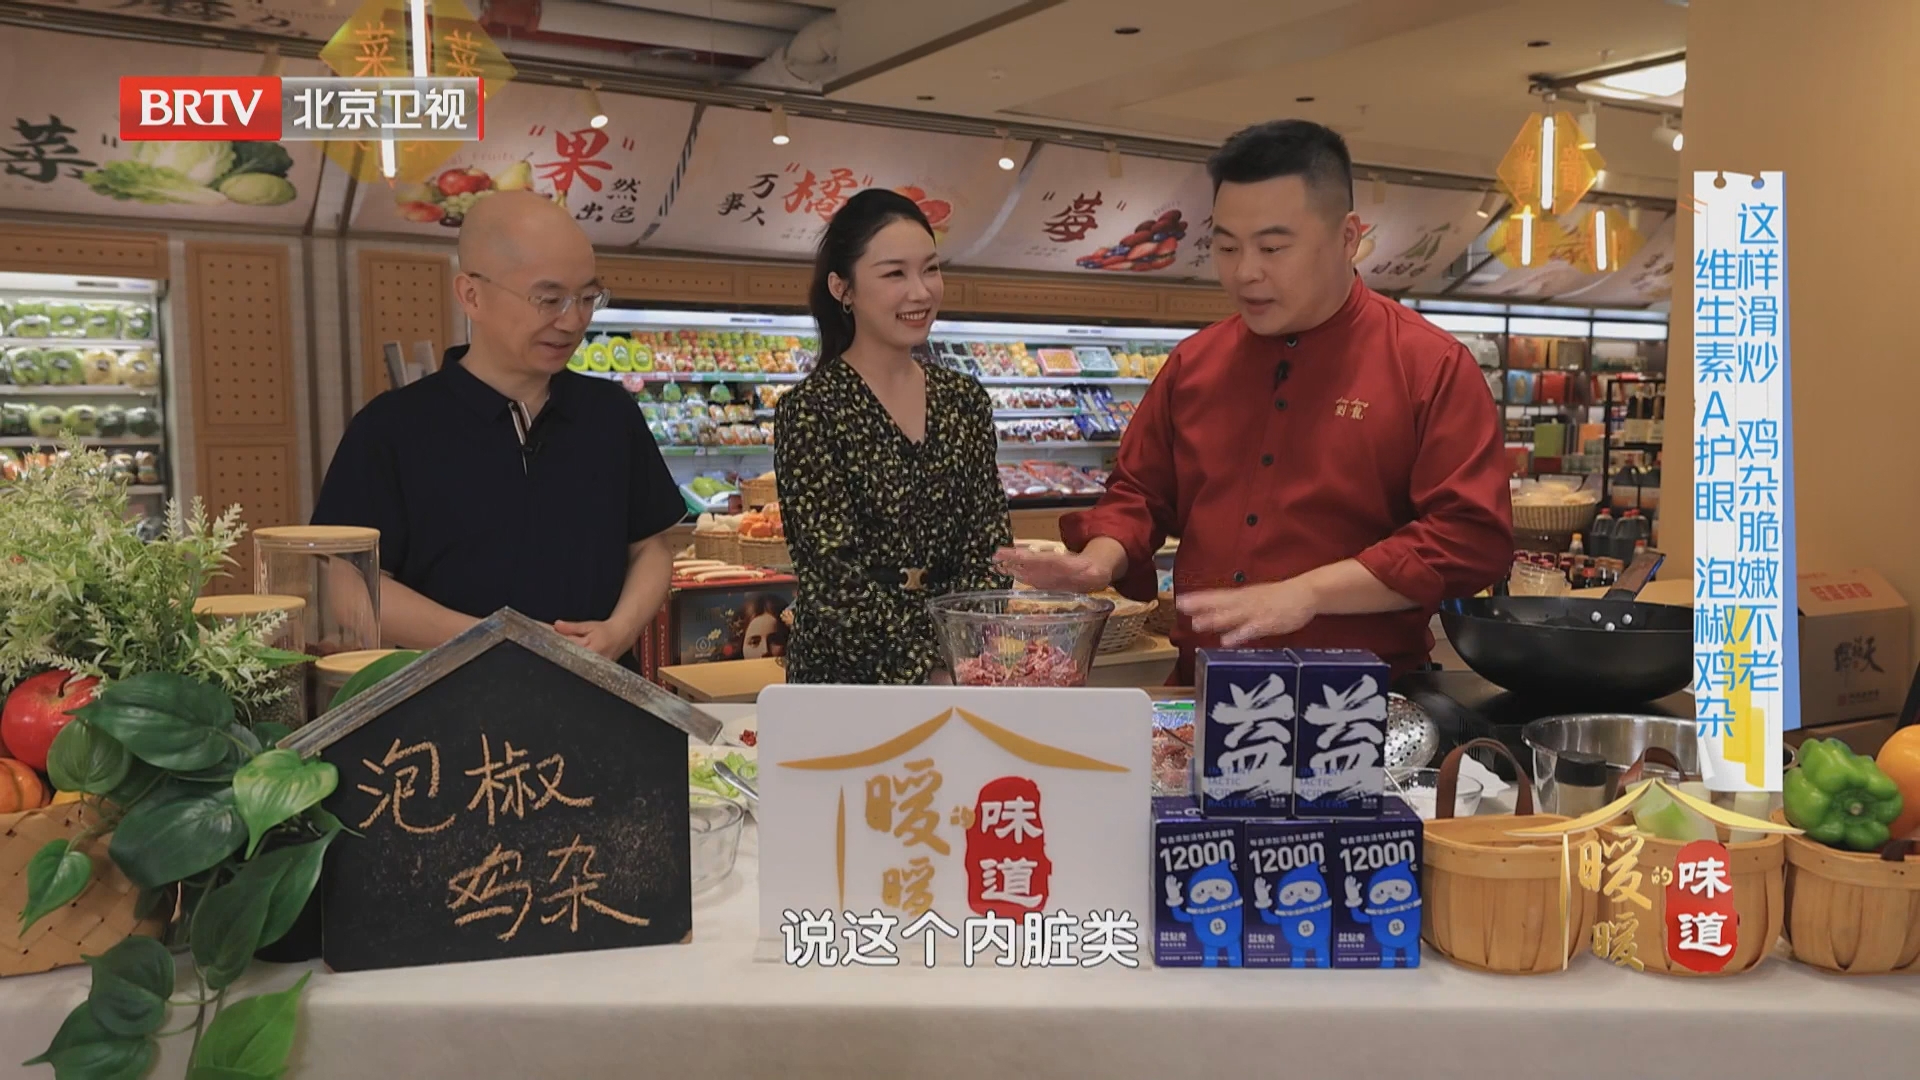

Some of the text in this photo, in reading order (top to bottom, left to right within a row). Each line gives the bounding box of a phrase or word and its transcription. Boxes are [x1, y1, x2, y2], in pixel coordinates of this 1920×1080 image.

[358, 734, 594, 834] 泡椒
[447, 834, 650, 941] 鸡杂
[865, 758, 950, 917] 暖暖
[980, 796, 1044, 906] 味道
[1160, 840, 1235, 872] 12000
[1249, 842, 1325, 874] 12000
[1340, 840, 1416, 872] 12000
